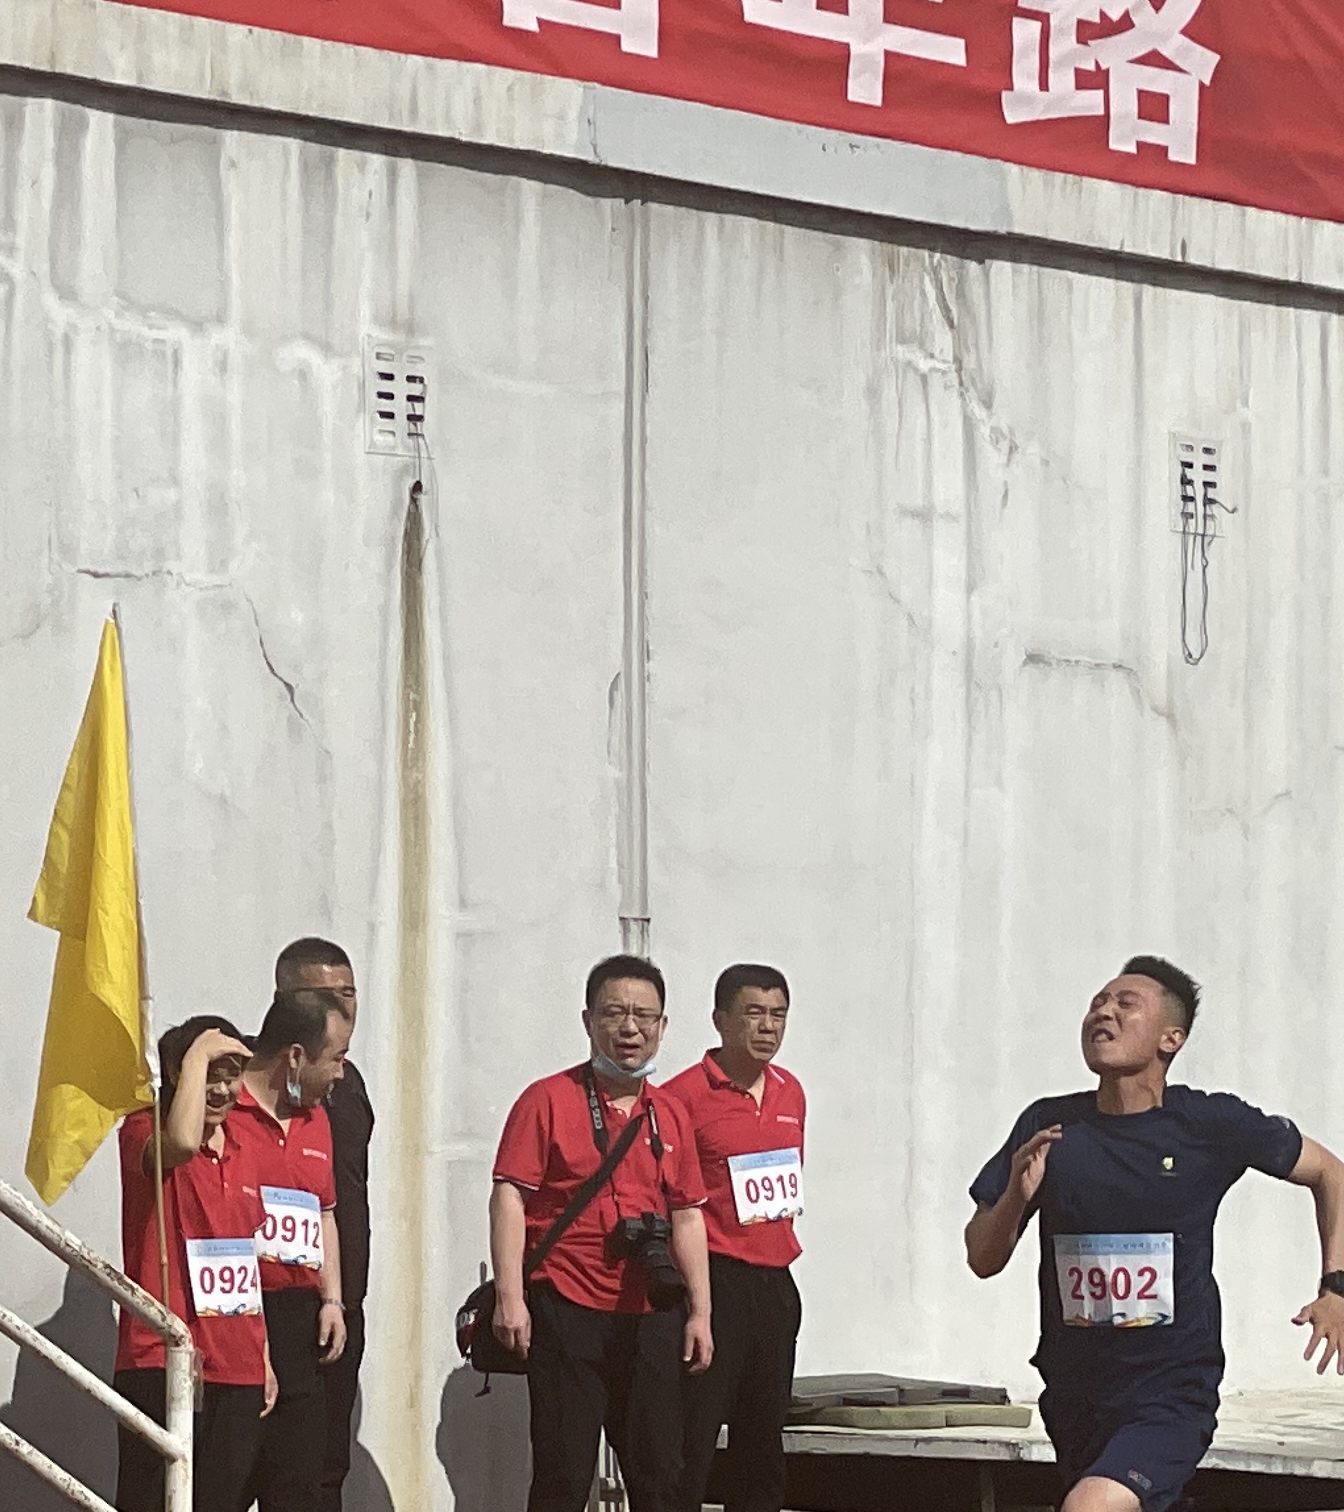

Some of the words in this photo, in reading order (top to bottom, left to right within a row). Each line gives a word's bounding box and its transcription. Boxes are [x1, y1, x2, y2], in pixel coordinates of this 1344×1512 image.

[745, 1172, 798, 1204] 0919
[261, 1213, 320, 1250] 0912
[1068, 1266, 1158, 1301] 2902
